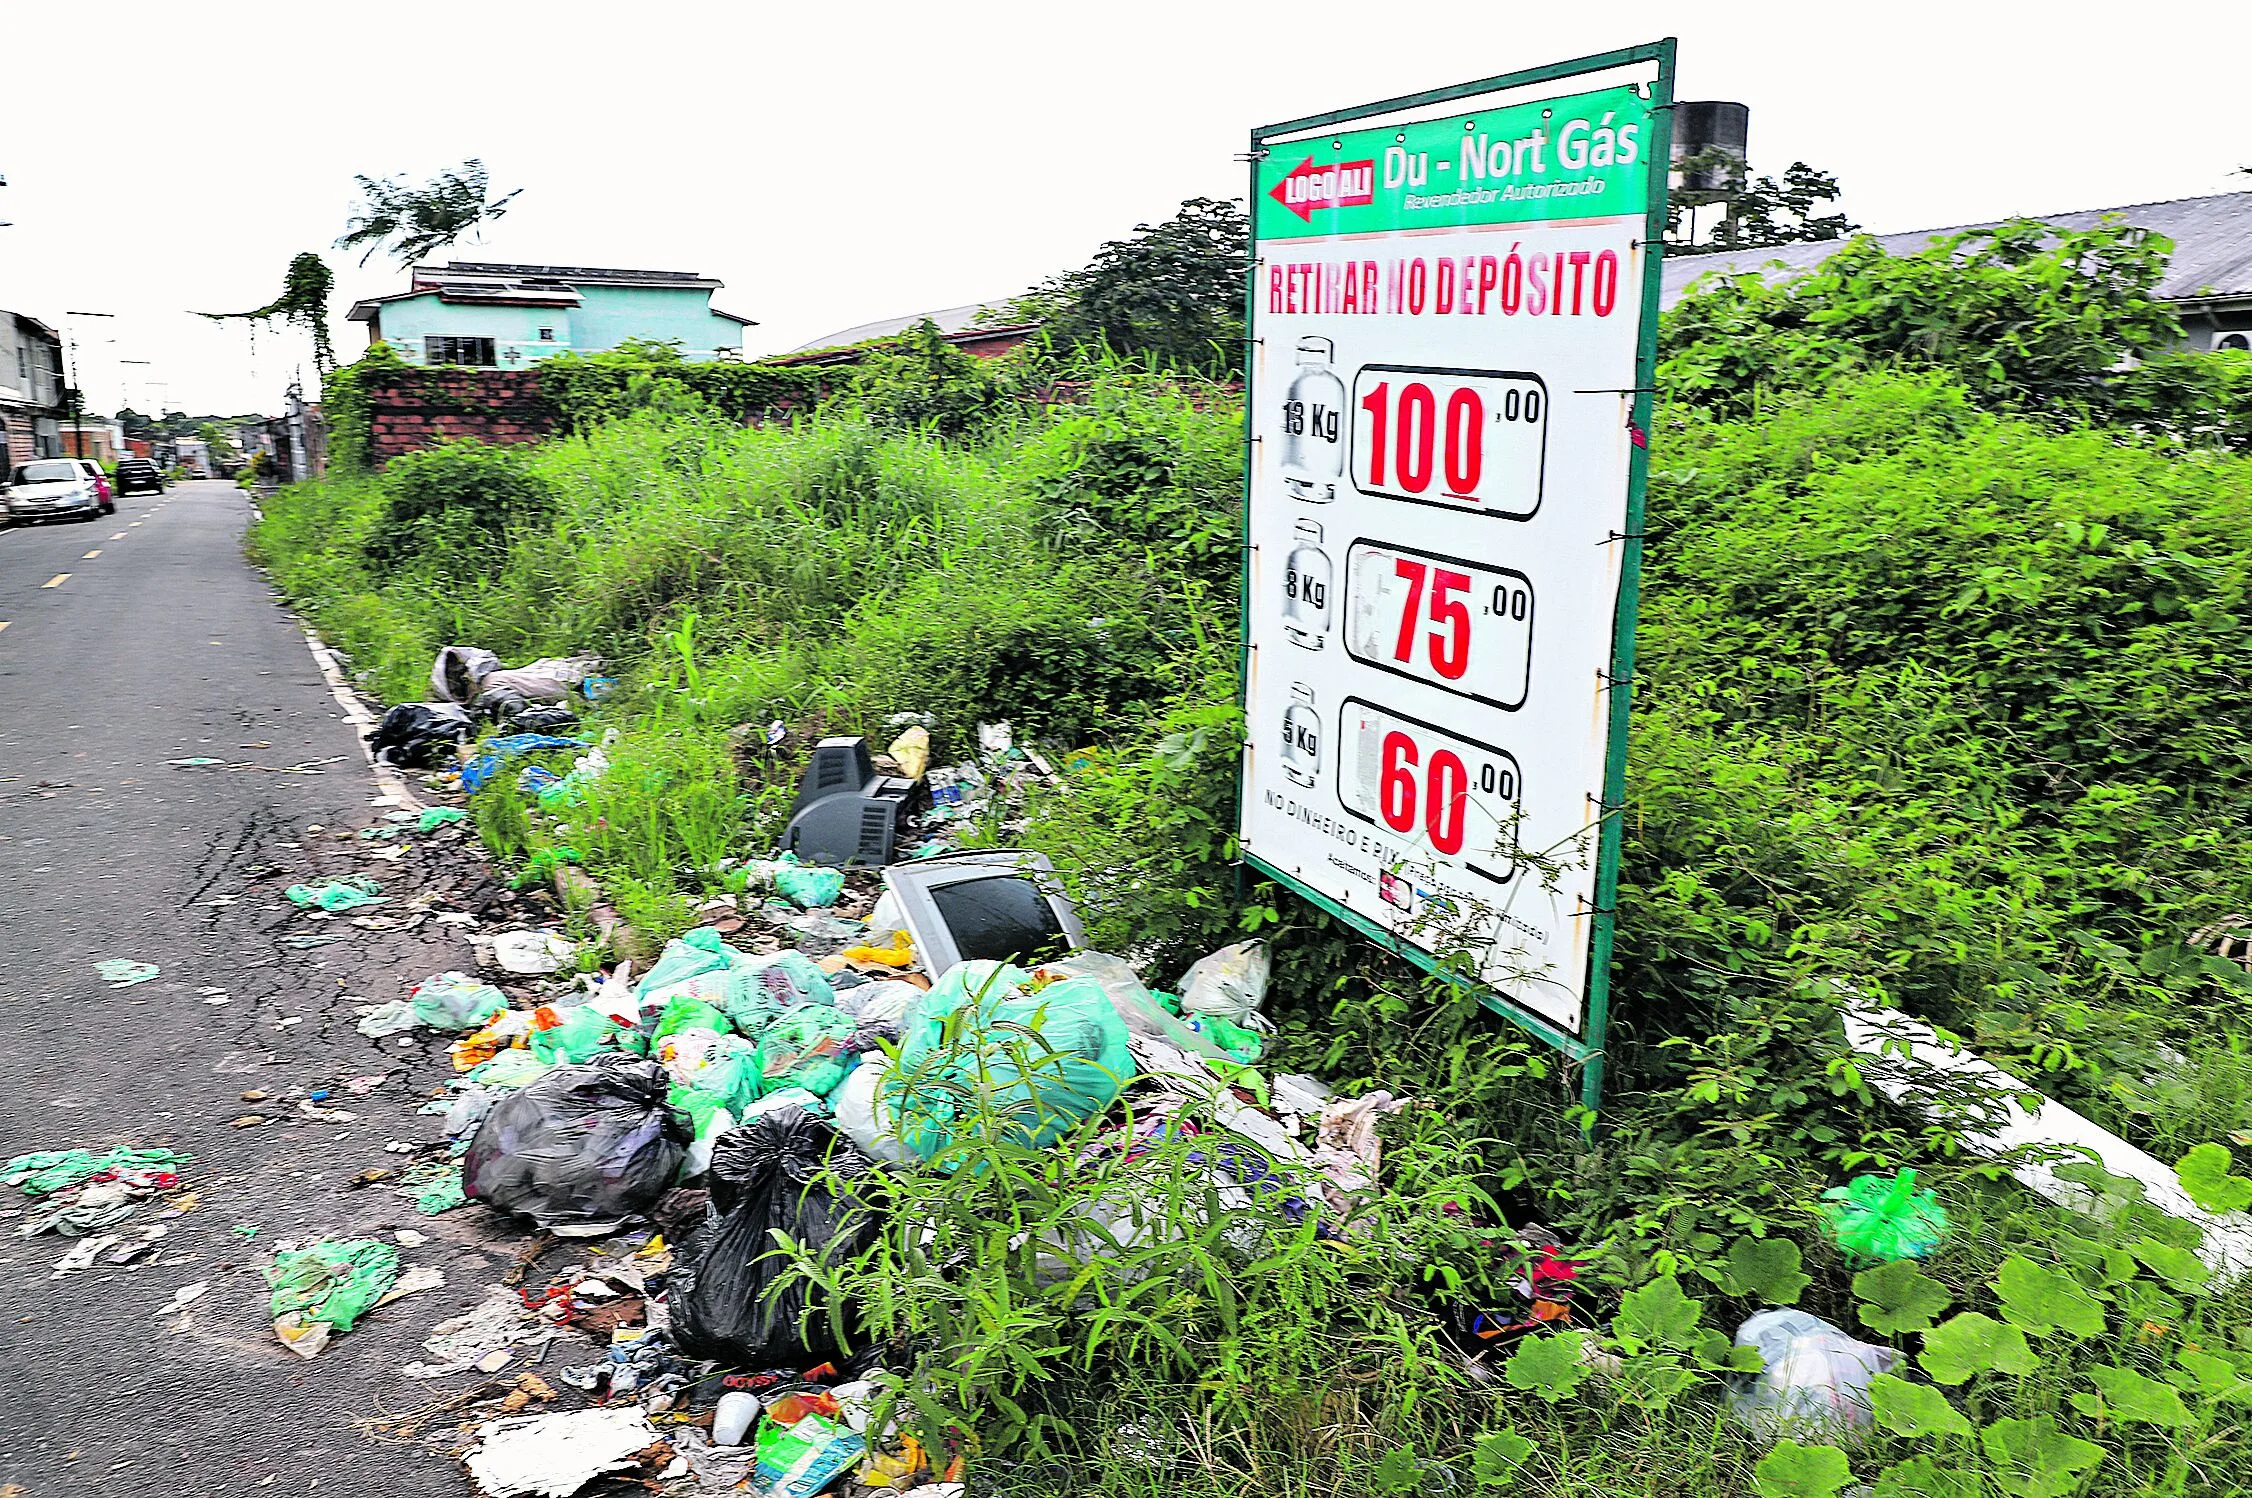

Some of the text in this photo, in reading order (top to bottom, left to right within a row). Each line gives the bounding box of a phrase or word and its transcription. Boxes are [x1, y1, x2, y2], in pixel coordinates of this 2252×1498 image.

[1384, 146, 1428, 189] Du
[1459, 128, 1547, 181] Nort
[1557, 111, 1639, 170] Gás
[1285, 167, 1373, 204] LOGO ALI
[1404, 176, 1605, 210] Revendedor Autorizado
[1269, 242, 1619, 317] RETIRAR NO DEPÓSITO
[1282, 400, 1338, 443] 13 Kg
[1303, 574, 1325, 609] Kg
[1297, 725, 1317, 756] Kg
[1264, 789, 1400, 865] NO DINHEIRO E PIX
